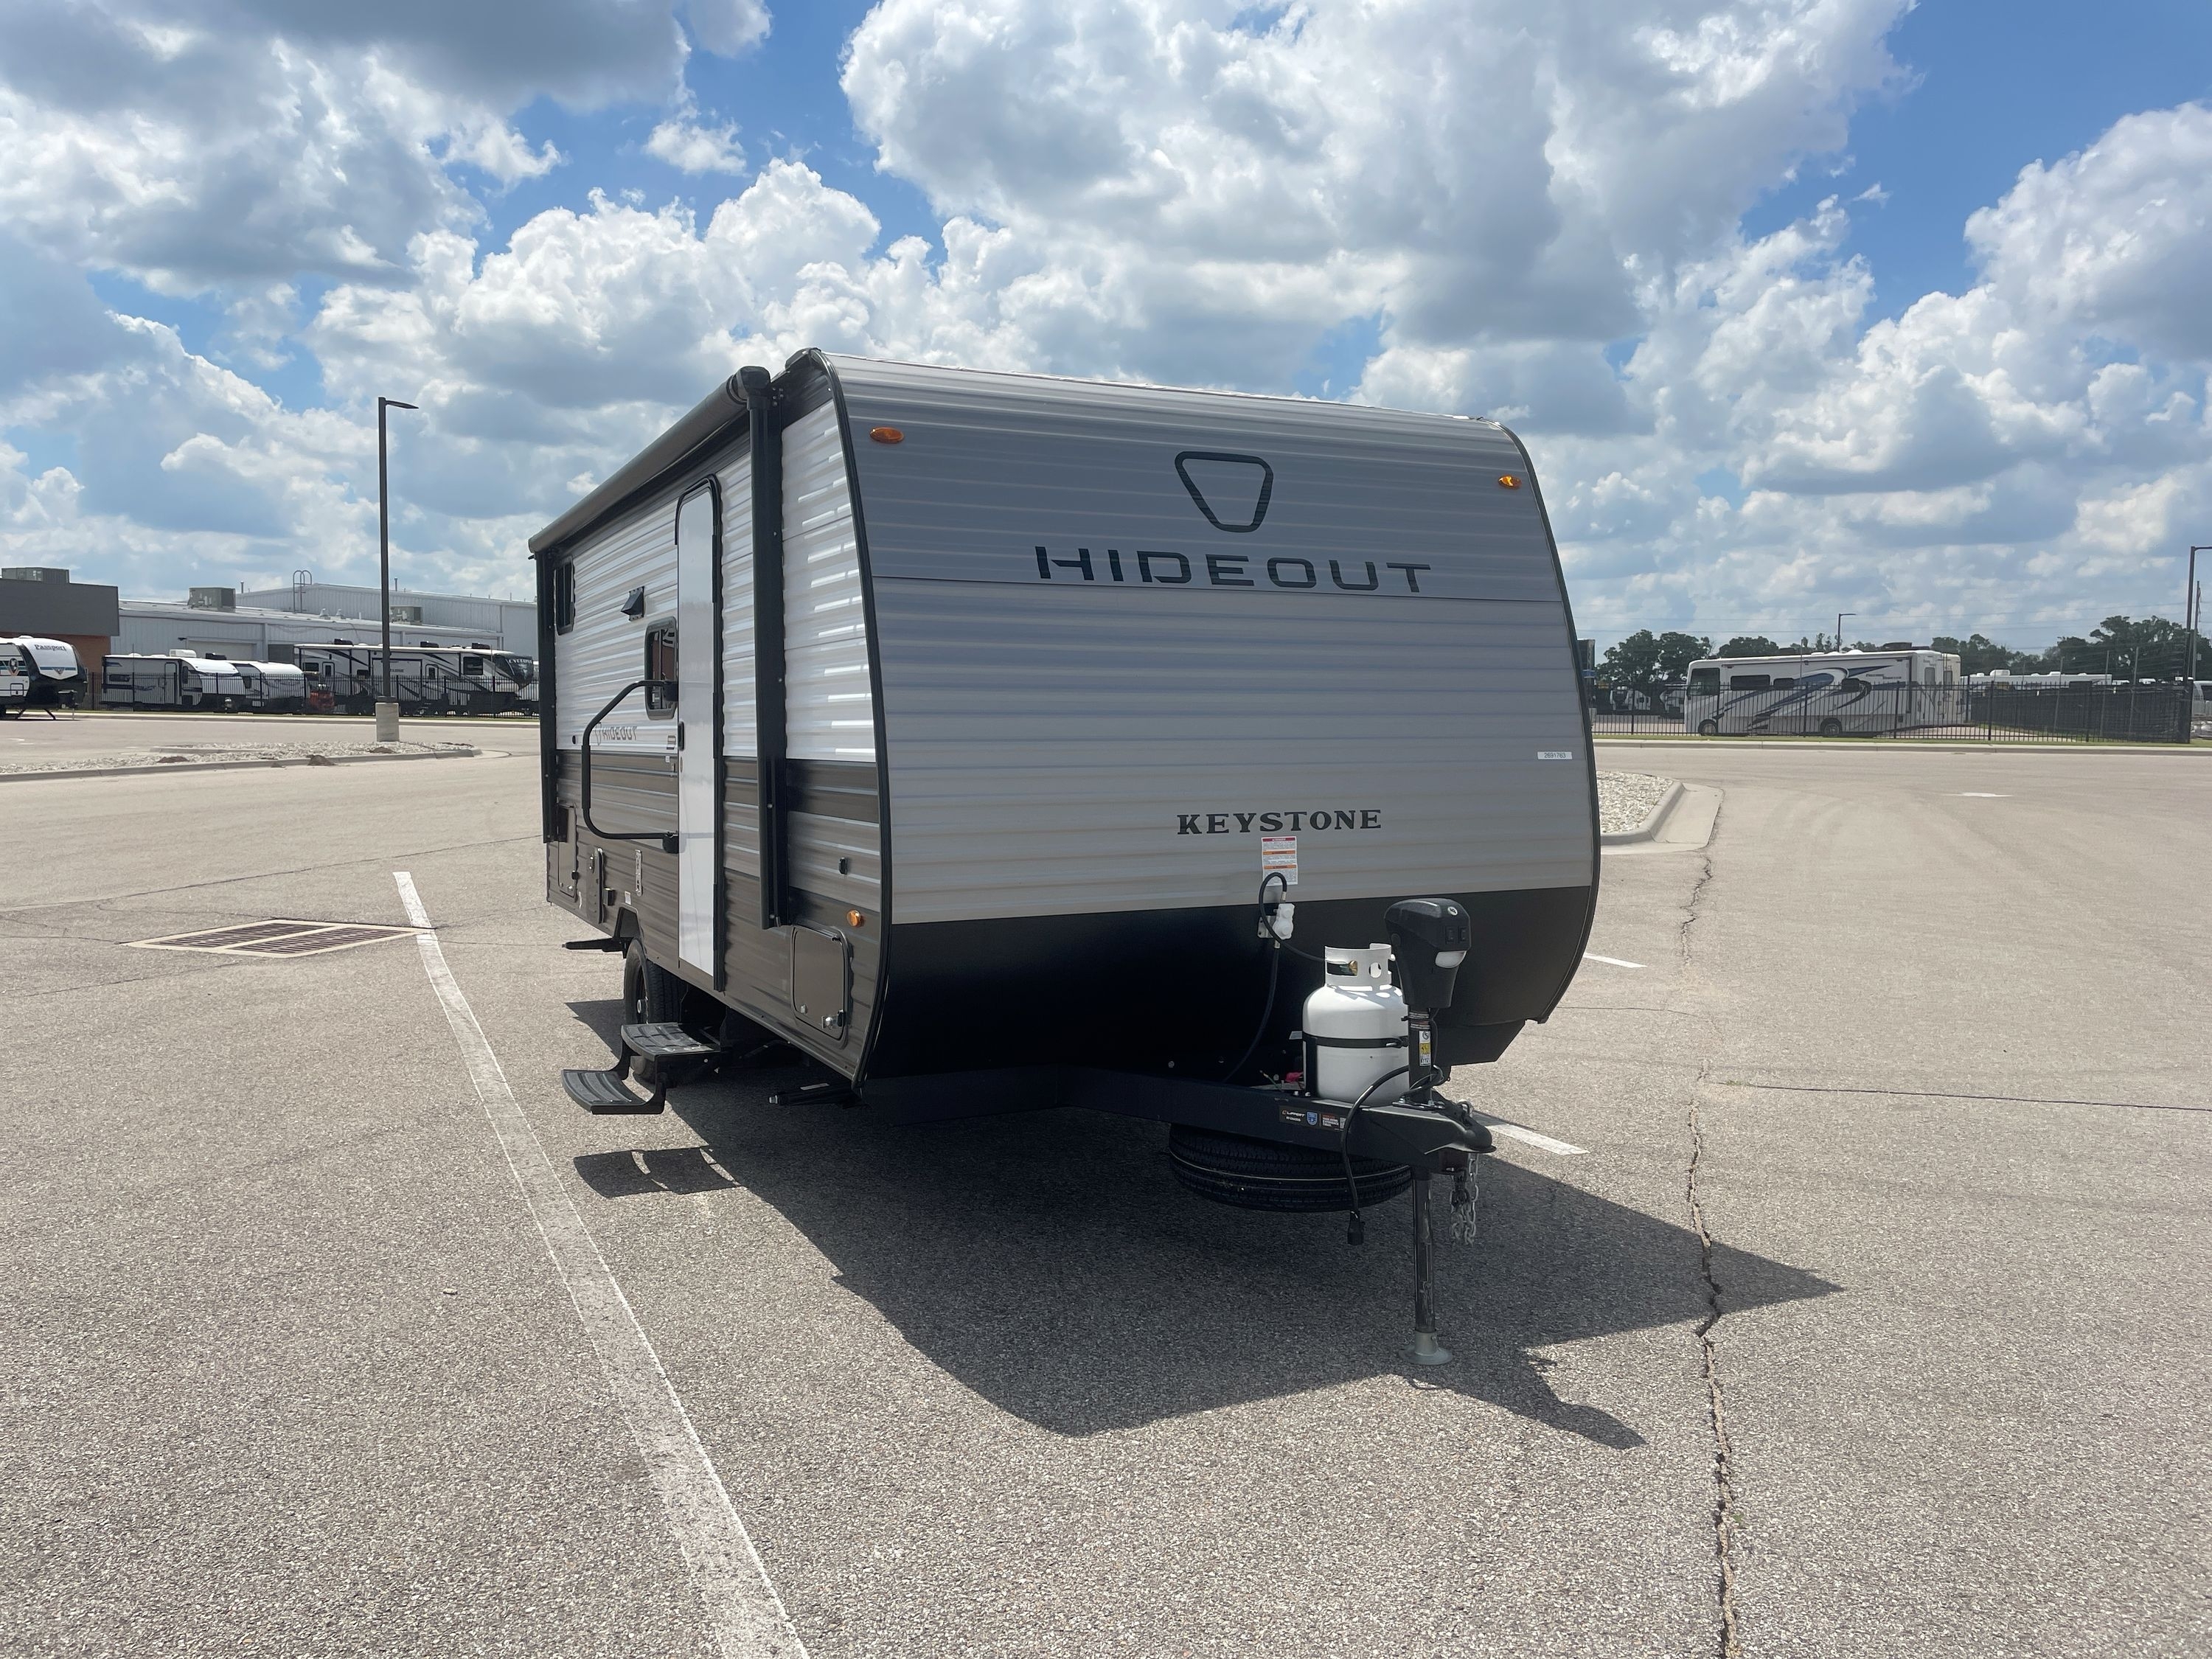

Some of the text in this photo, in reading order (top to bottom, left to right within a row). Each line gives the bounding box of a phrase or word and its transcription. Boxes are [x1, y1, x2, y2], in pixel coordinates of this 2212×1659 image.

[1034, 546, 1431, 593] HIDEOUT
[602, 726, 637, 740] HIDEOUT
[1177, 809, 1381, 835] KEYSTONE
